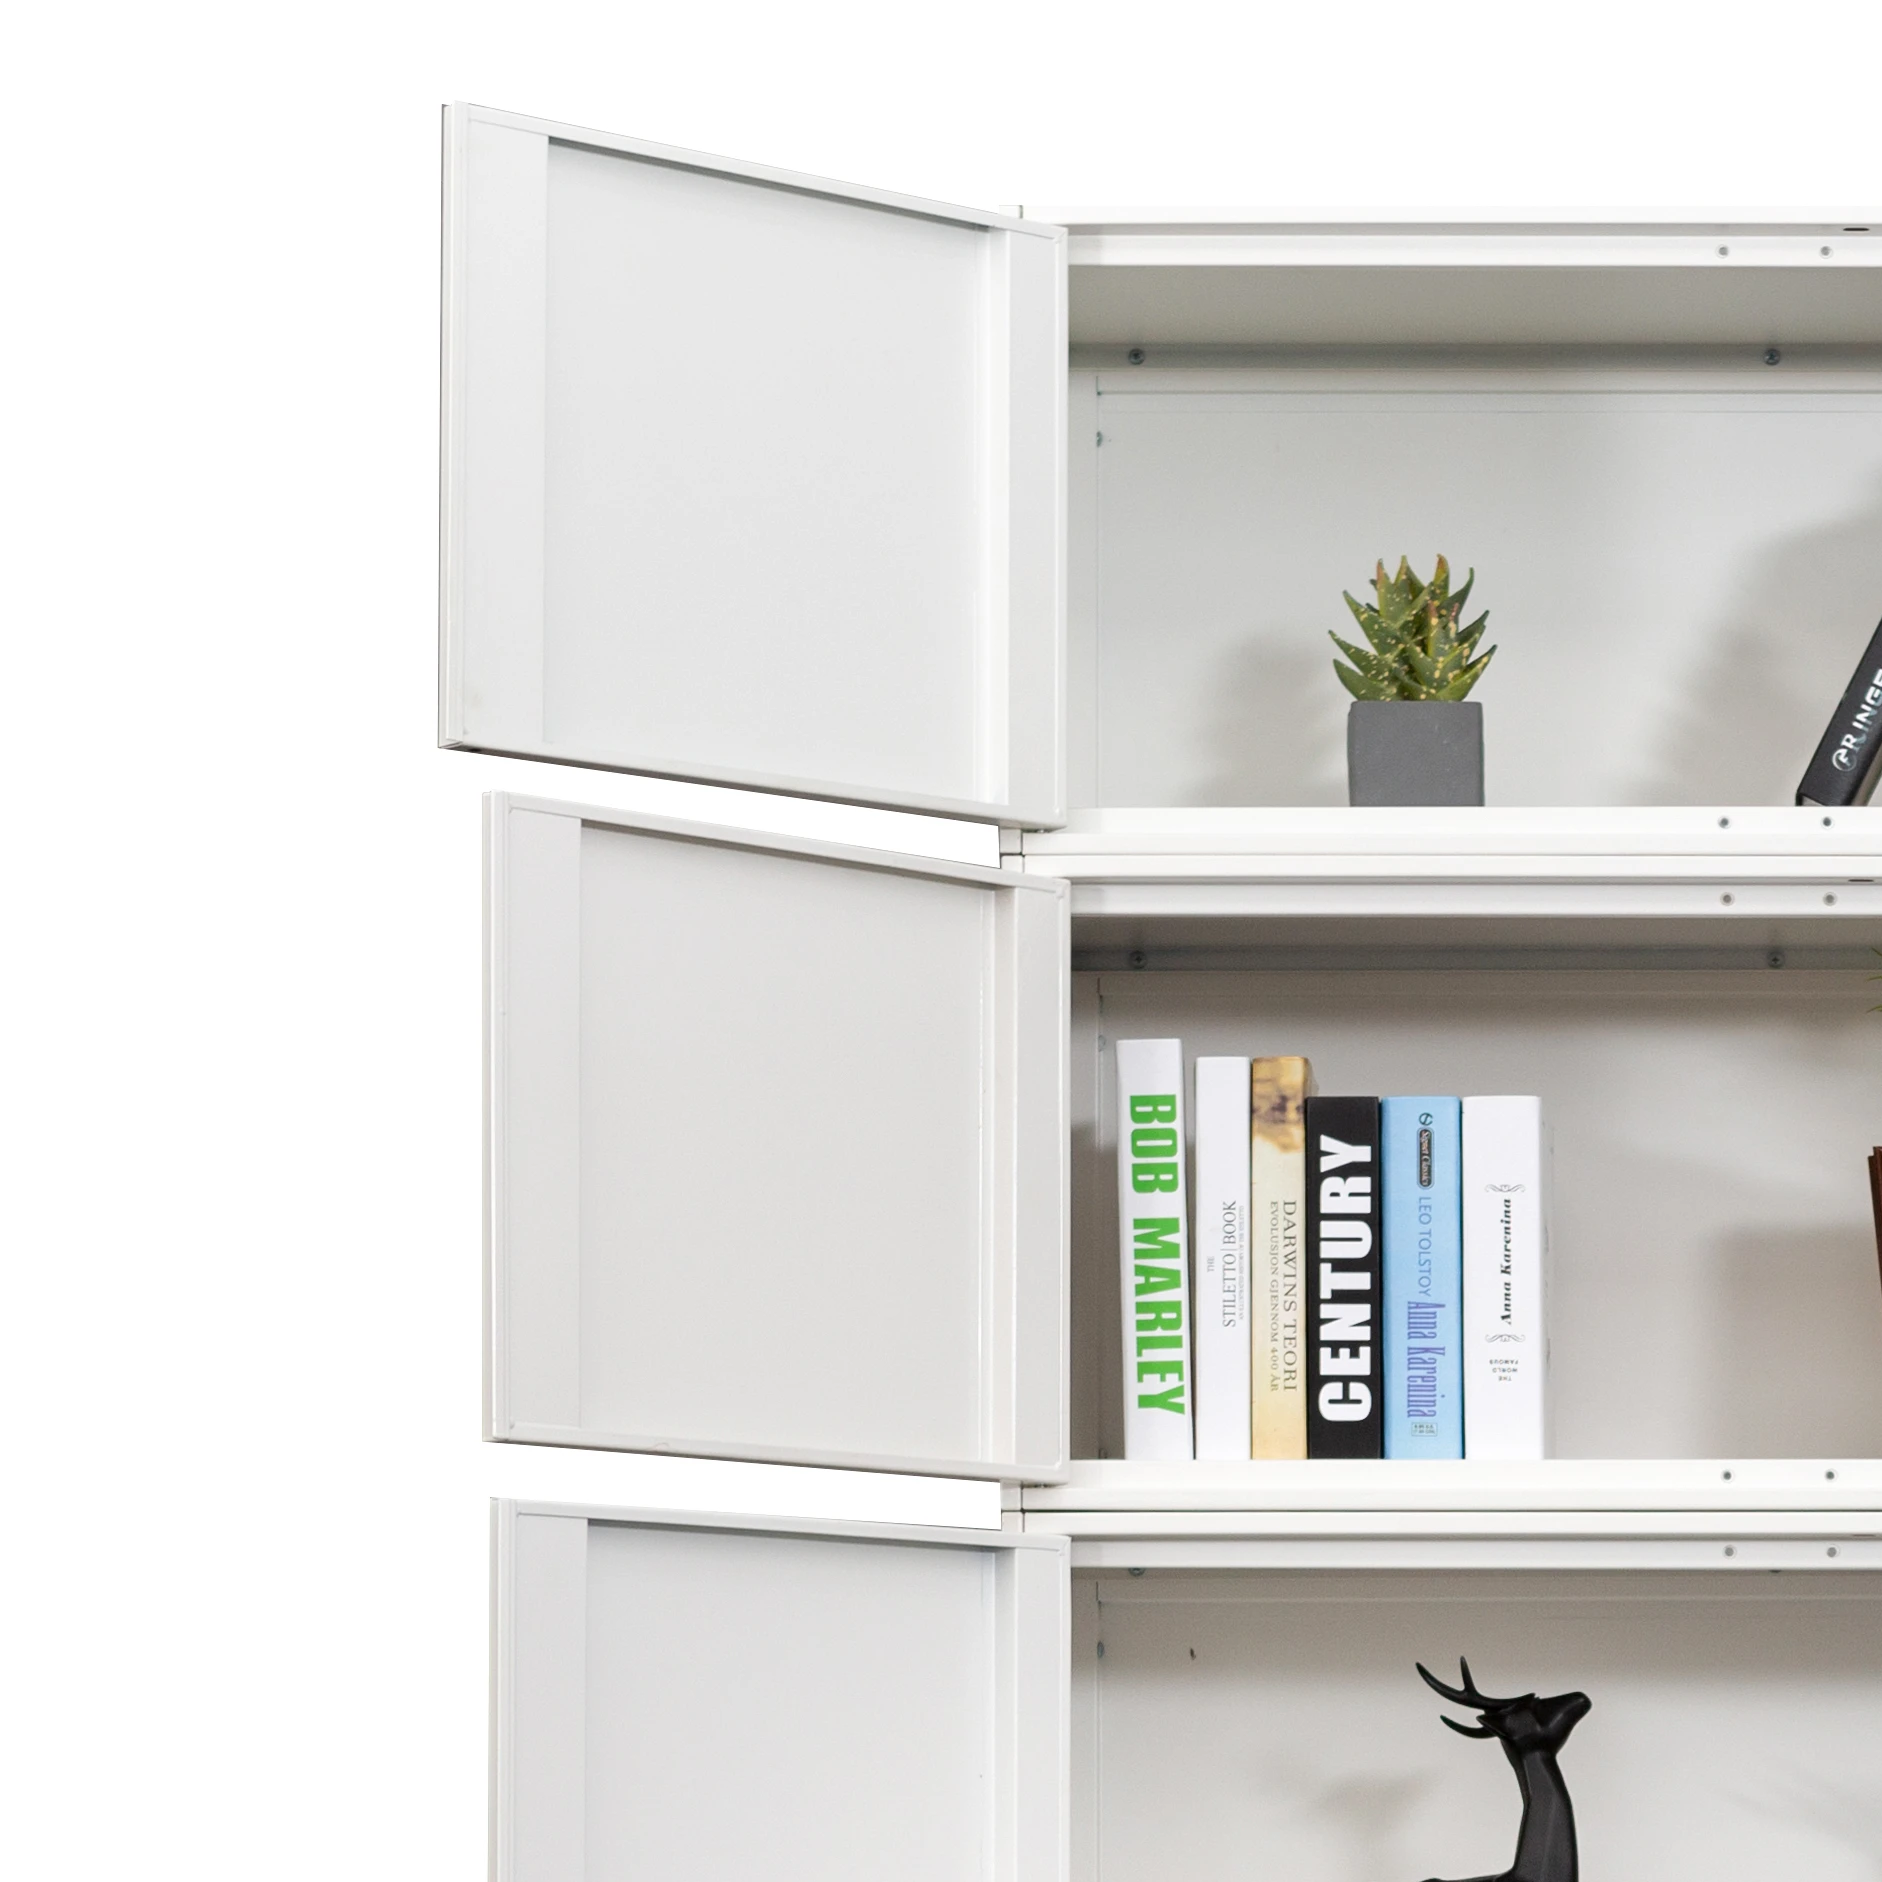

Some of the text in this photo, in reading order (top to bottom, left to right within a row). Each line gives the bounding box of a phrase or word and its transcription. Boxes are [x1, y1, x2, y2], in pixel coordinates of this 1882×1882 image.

[1129, 1094, 1186, 1416] BOB MARLEY
[1207, 1256, 1215, 1273] THE
[1222, 1200, 1237, 1328] STILETTO BOOK
[1270, 1201, 1280, 1392] EVOLUSJON GJENNOM 400 ÅR
[1283, 1200, 1298, 1392] DARWINS TEORI
[1318, 1134, 1373, 1423] CENTURY
[1418, 1197, 1432, 1297] LEO TOLSTOY
[1500, 1198, 1512, 1325] Anna Karenina
[1406, 1301, 1446, 1340] Anna
[1406, 1345, 1446, 1419] Karenina
